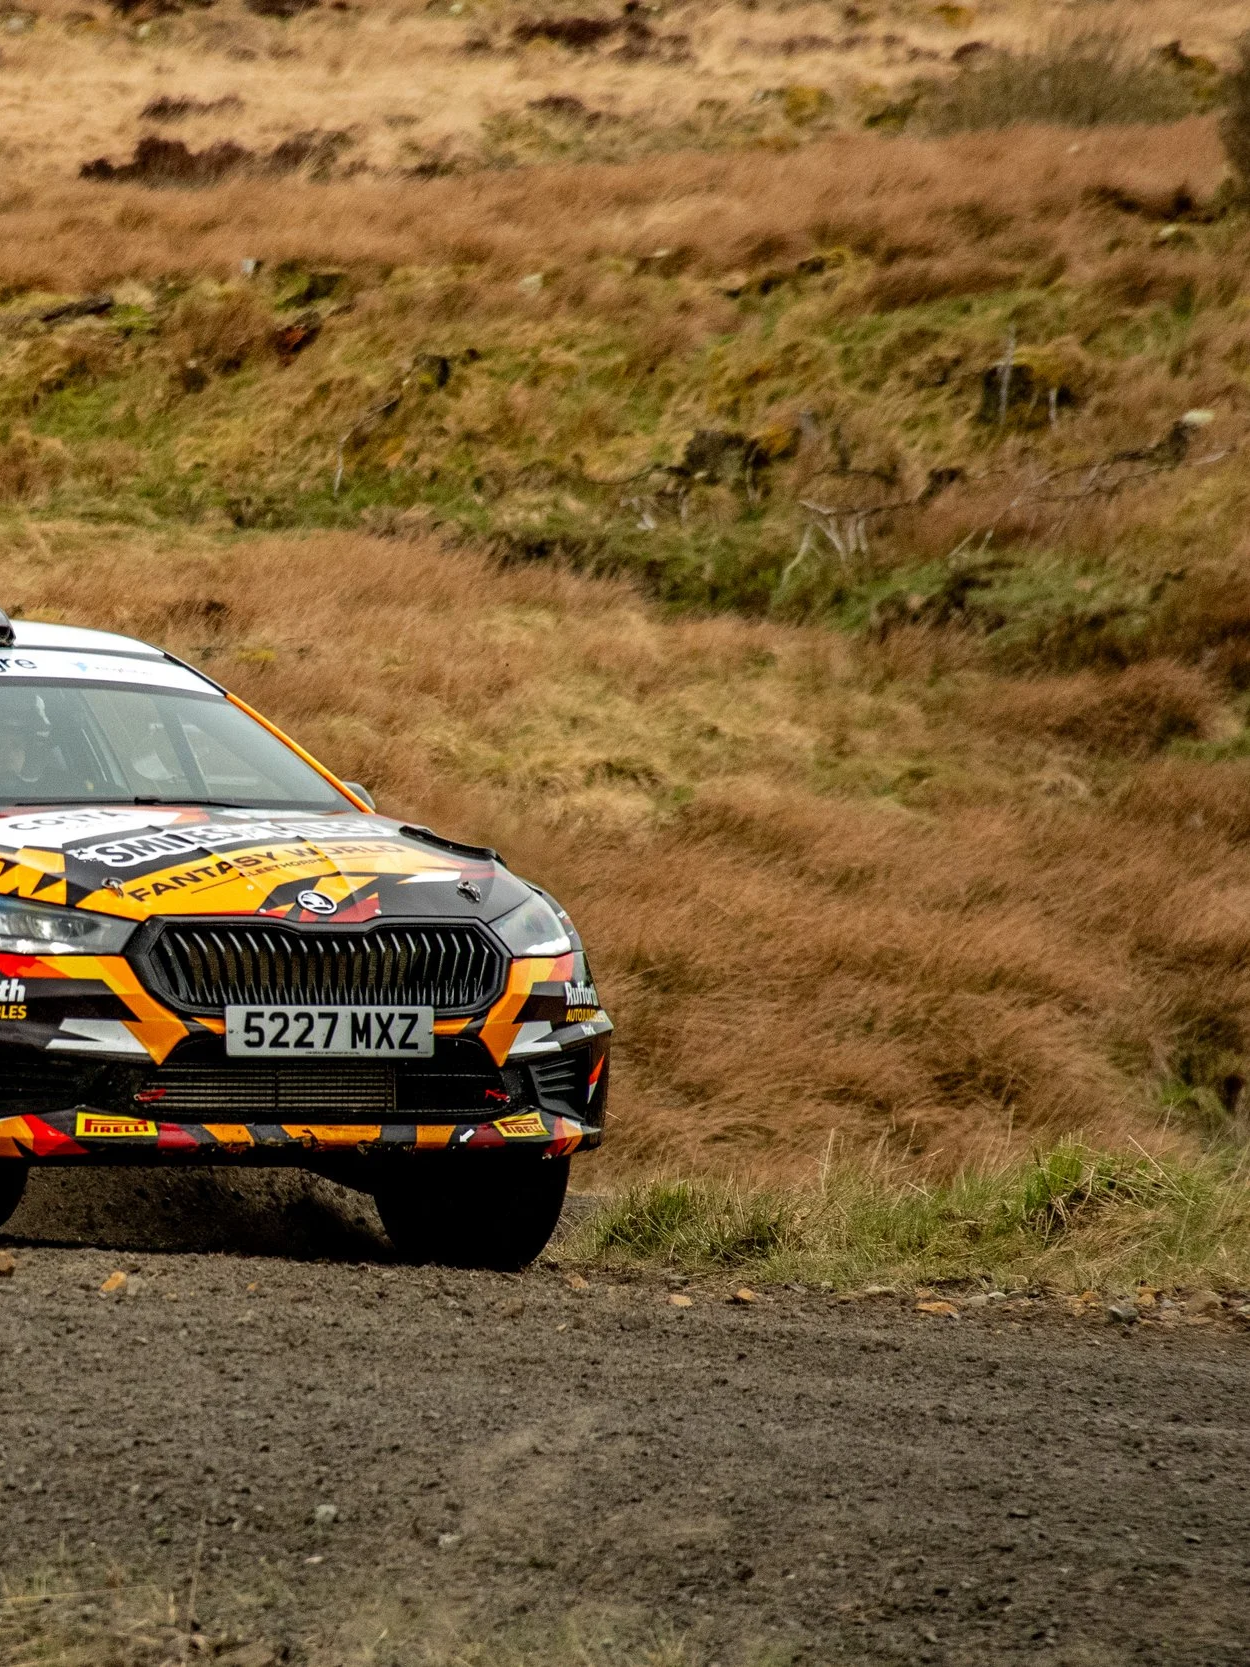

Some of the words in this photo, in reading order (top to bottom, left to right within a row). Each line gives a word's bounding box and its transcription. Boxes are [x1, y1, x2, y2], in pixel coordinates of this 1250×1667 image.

[128, 851, 278, 902] FANTASY
[292, 844, 405, 858] WORLD
[243, 1011, 339, 1049] 5227
[350, 1012, 419, 1050] MXZ
[84, 1118, 150, 1133] PIRELLI
[499, 1117, 545, 1134] PIRELLI
